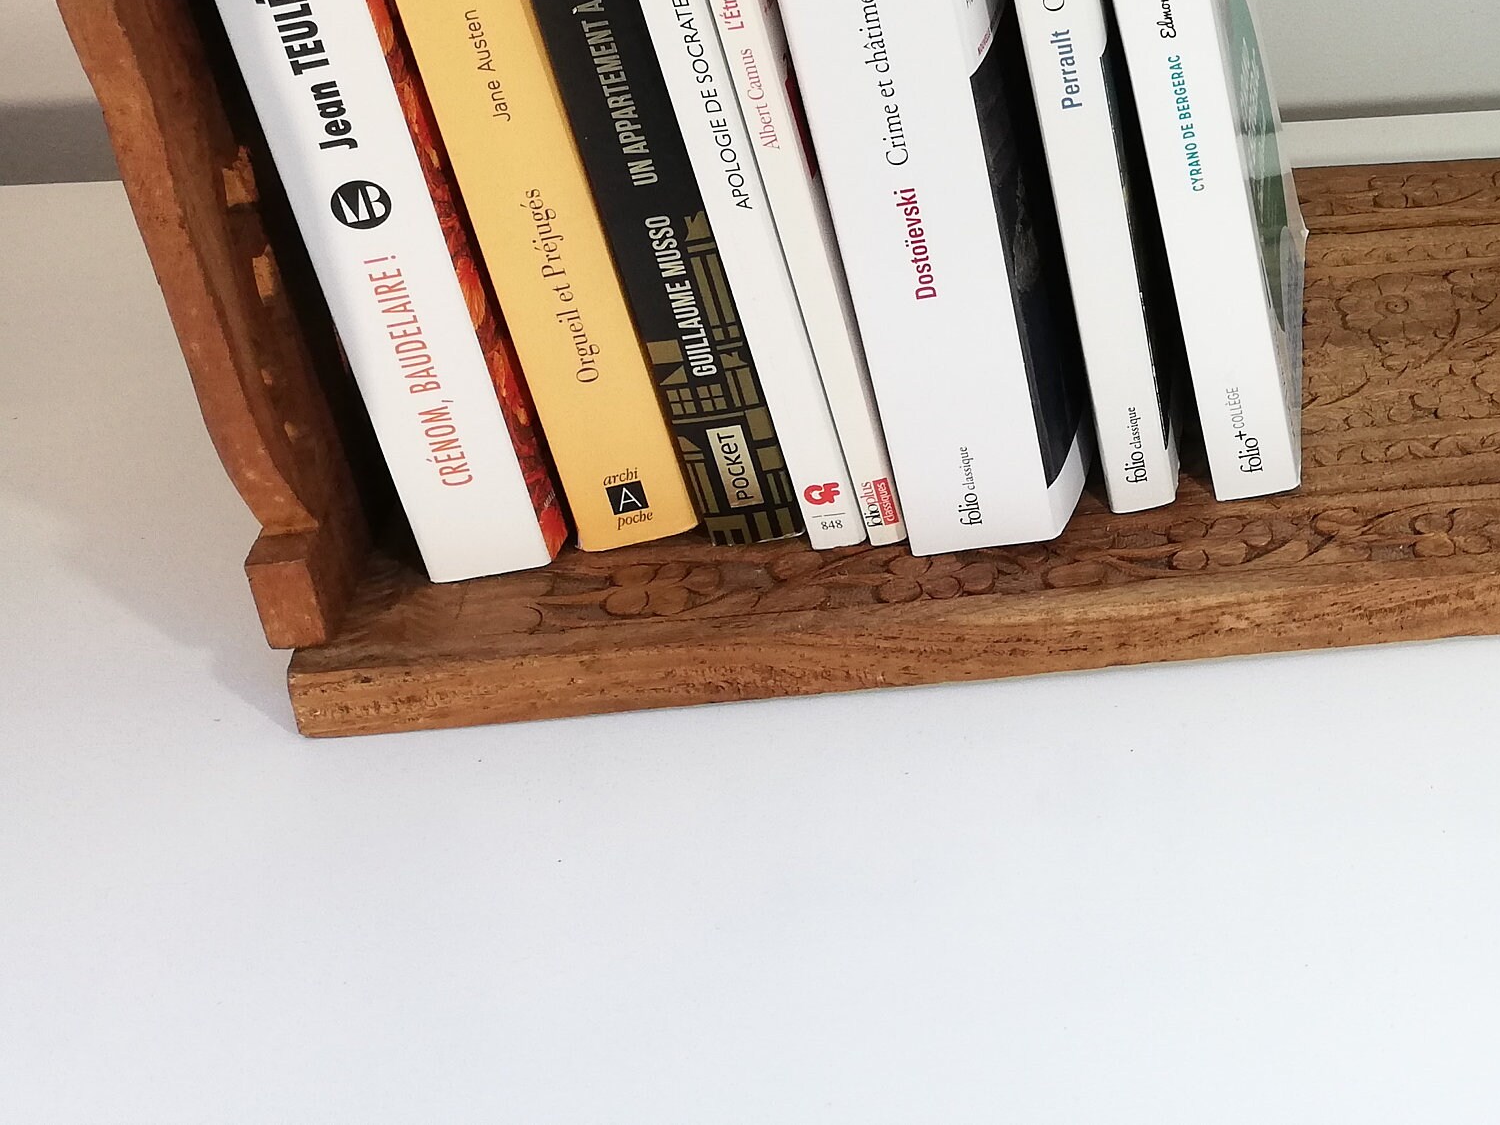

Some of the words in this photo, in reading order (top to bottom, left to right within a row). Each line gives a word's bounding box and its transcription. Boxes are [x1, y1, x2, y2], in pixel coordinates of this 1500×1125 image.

[464, 8, 496, 73] Austen
[581, 20, 650, 155] APPARTEMENT
[740, 48, 765, 100] Camus
[879, 78, 896, 98] et
[1050, 28, 1083, 110] Perrault
[1167, 54, 1192, 121] BERGERAC
[310, 80, 358, 150] Jean
[488, 79, 511, 122] Jane
[700, 87, 723, 114] DE
[755, 102, 780, 150] Albert
[882, 103, 909, 166] Crime
[1182, 122, 1197, 140] DE
[627, 158, 658, 187] UN
[710, 117, 753, 210] APOLOGIE
[1184, 141, 1205, 192] CYRANO
[520, 187, 568, 279] Préjugés
[645, 215, 687, 277] MUSSO
[893, 187, 937, 300] Dostoïevski
[552, 283, 574, 302] et
[368, 267, 442, 394] BAUDELAIRE
[556, 308, 601, 383] Orgueil
[664, 279, 718, 377] GUILLAUME
[418, 399, 474, 488] CRÉNOM,
[1125, 406, 1143, 450] classique
[603, 467, 639, 487] archi
[959, 445, 977, 491] classique
[1126, 451, 1148, 485] folio
[616, 509, 654, 530] poche
[618, 486, 644, 512] A
[877, 481, 896, 522] classiques
[959, 491, 984, 527] folio
[820, 519, 844, 531] 848
